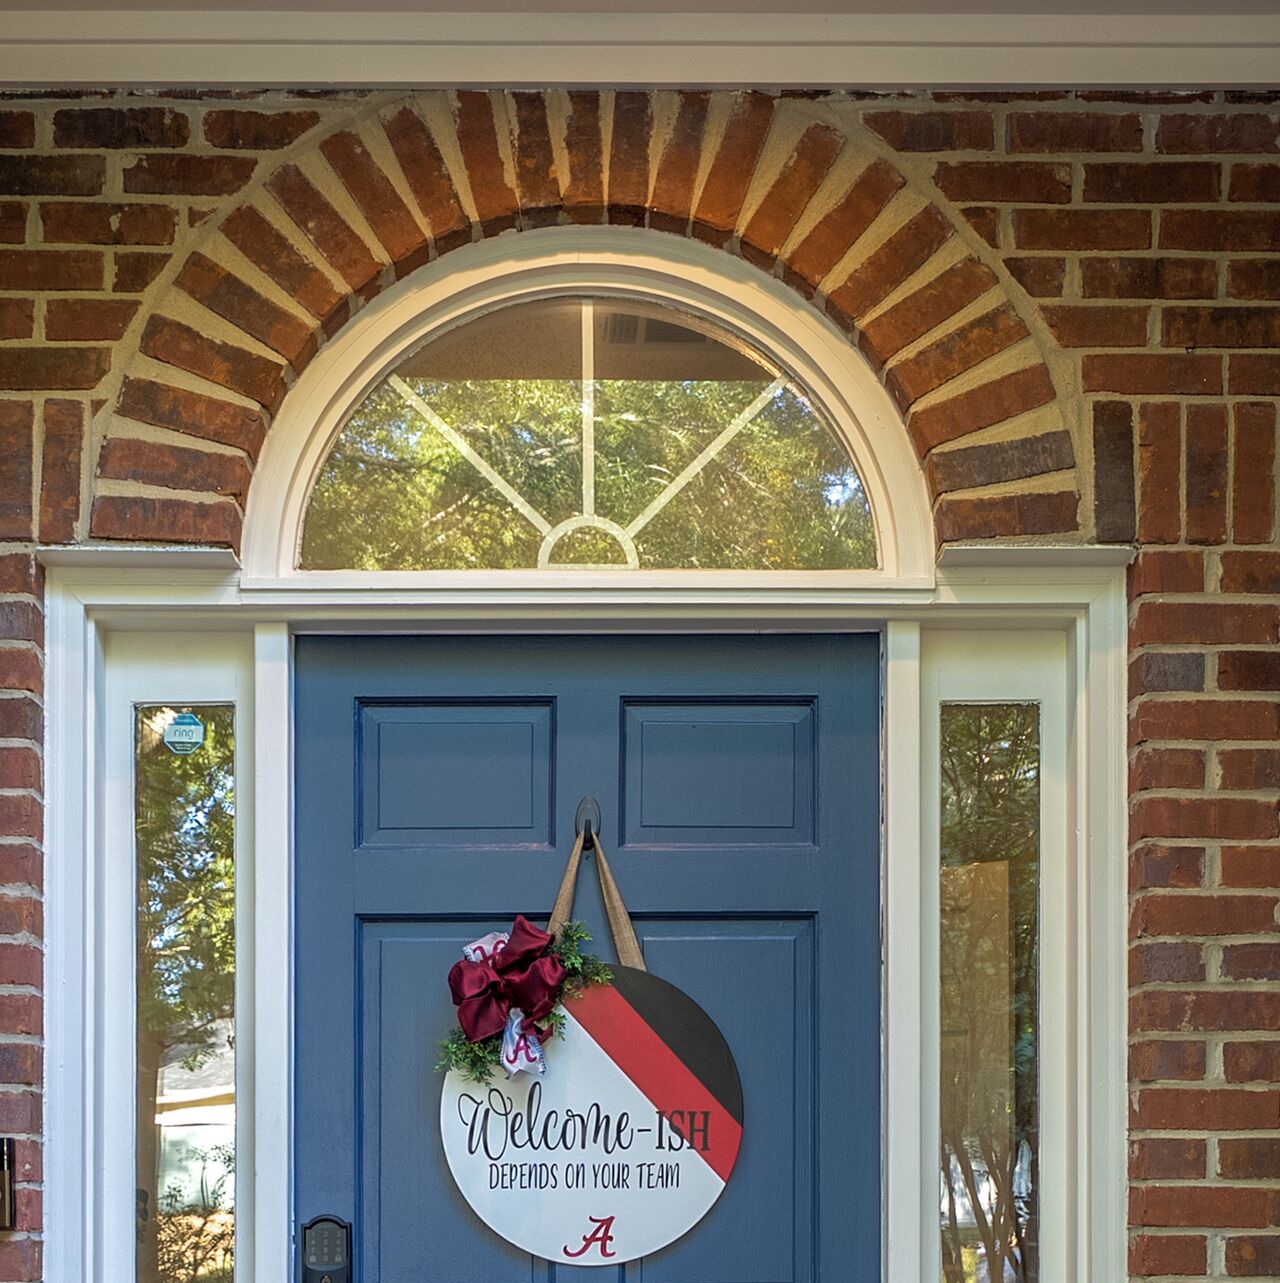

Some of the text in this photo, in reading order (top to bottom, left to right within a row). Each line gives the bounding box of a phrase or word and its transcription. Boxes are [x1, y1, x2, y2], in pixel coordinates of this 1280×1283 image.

[173, 727, 194, 740] ring
[488, 1162, 681, 1190] DEPENDS ON YOUR TEAM
[562, 1215, 617, 1258] A
